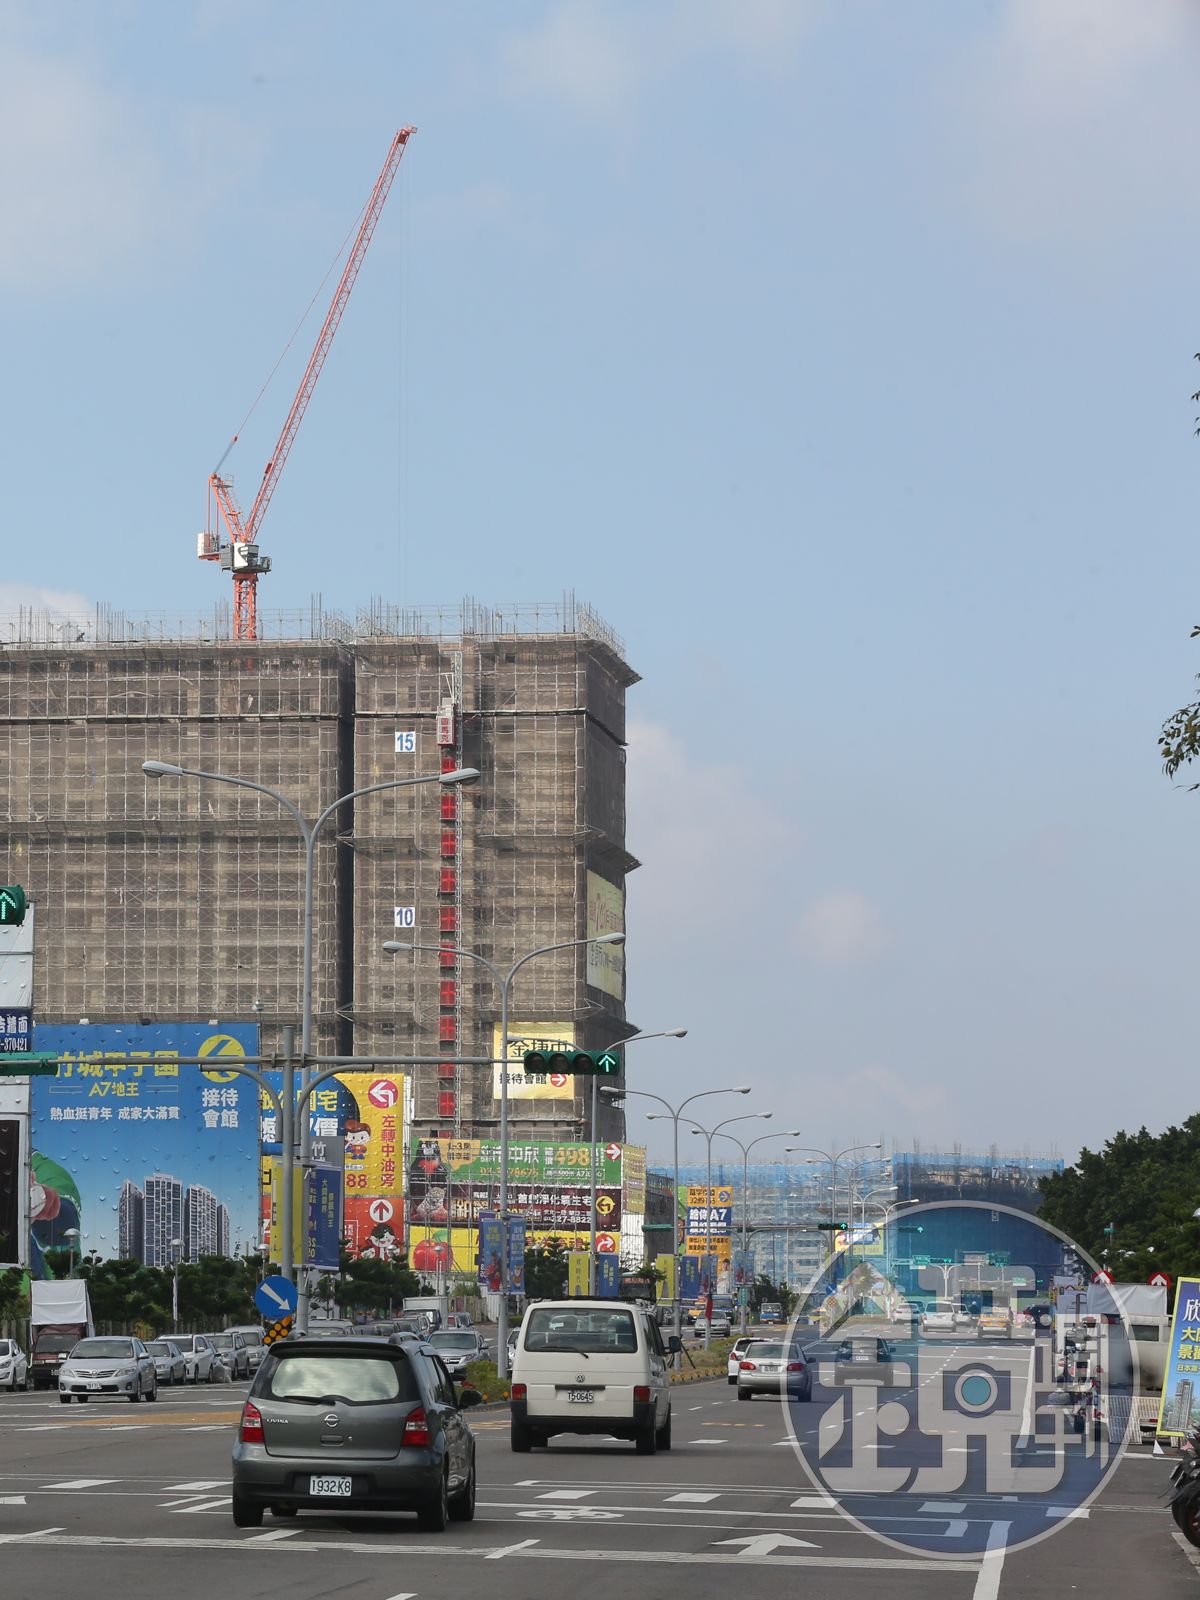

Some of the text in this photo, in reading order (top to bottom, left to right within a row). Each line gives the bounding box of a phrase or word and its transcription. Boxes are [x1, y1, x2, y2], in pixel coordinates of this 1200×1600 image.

[396, 733, 414, 751] 15
[396, 907, 414, 926] 10
[89, 1082, 139, 1097] A7地王
[202, 1088, 239, 1107] 接待
[50, 1107, 180, 1120] 熱血挺青年 成家大滿貫
[202, 1109, 239, 1128] 會館
